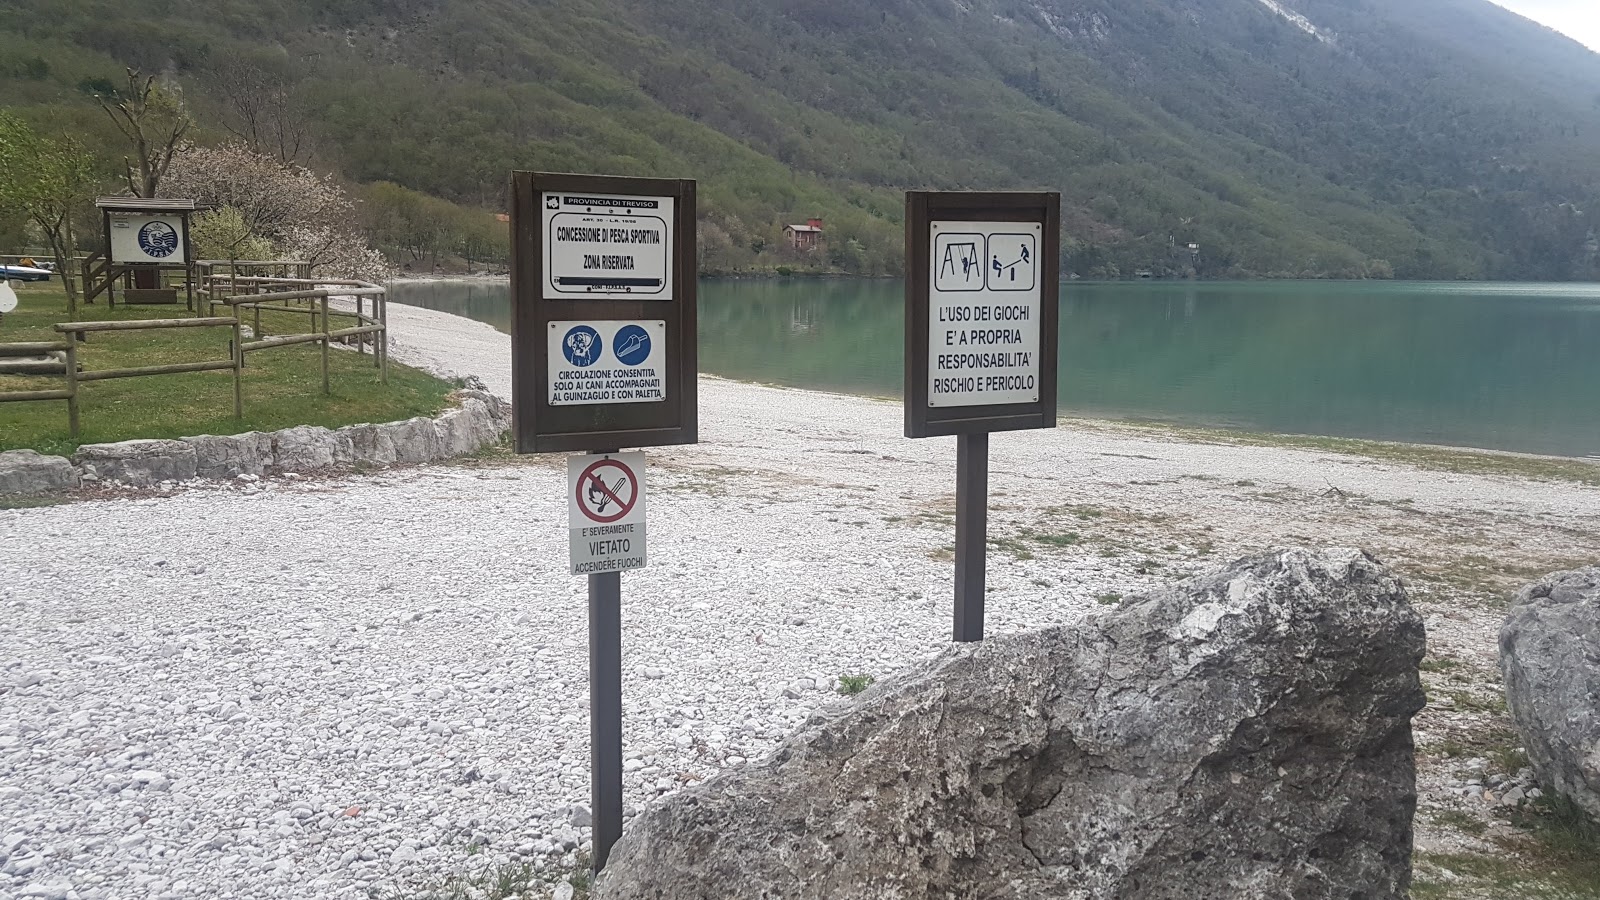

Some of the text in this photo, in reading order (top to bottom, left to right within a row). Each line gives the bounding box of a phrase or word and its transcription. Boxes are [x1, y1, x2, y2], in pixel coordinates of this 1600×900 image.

[557, 227, 660, 244] CONCESSIONE DI PESCA SPORTIVA
[584, 255, 634, 270] ZONA RISERVATA
[940, 305, 1030, 321] L'USO DEI GIOCHI
[946, 329, 1022, 345] E' A PROPRIA
[938, 352, 1032, 369] RESPONSABILITA'
[559, 369, 655, 380] CIRCOLAZIONE CONSENTITA
[554, 379, 660, 391] SOLO AI CANI ACCOMPAGNATI
[934, 375, 1034, 393] RISCHIO E PERICOLO
[553, 389, 660, 401] AL GUINZAGLIO E CON PALETTA
[582, 524, 634, 537] E' SEVERAMENTE
[589, 539, 630, 556] VIETATO
[575, 557, 642, 573] ACCENDERE FUOCHI
